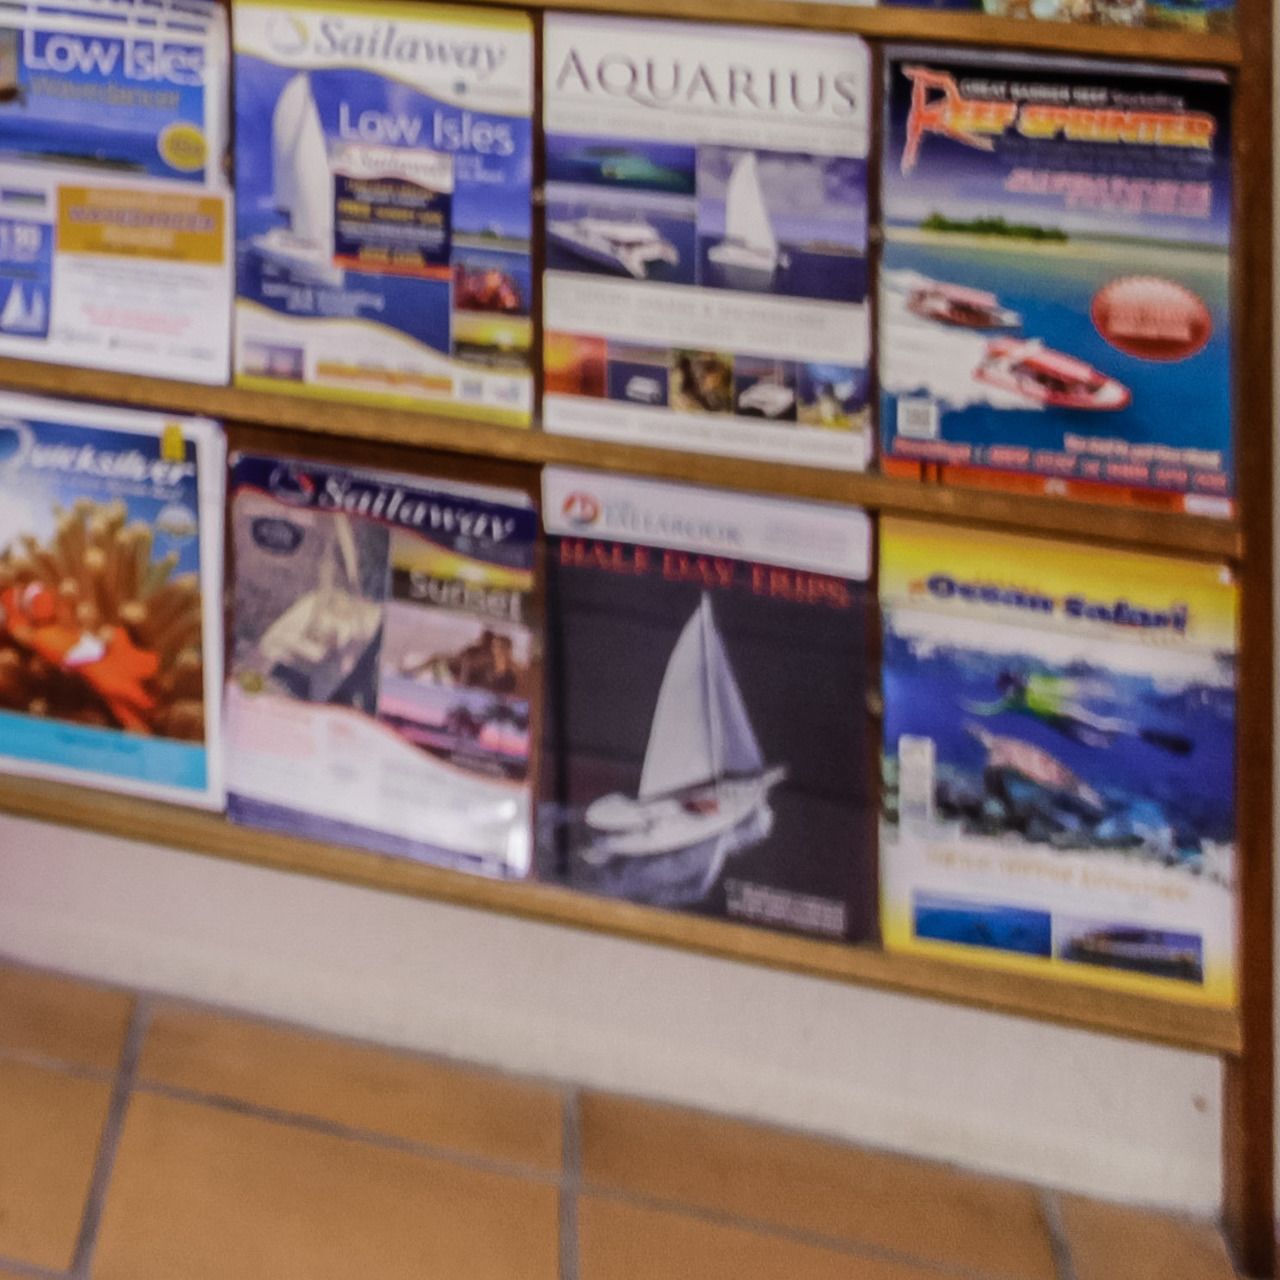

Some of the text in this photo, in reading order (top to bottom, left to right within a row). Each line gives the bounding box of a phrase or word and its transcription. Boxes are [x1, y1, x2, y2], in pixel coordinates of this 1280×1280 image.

[22, 28, 205, 87] Low Isles
[313, 14, 507, 82] Sailaway
[555, 46, 859, 117] AQUARIUS
[339, 101, 517, 158] Low Isles
[900, 65, 1216, 178] REEF SPRINTER
[318, 474, 516, 543] Sailaway
[410, 570, 522, 622] Sunset
[559, 536, 852, 608] HALF DAY TRIPS
[926, 572, 1188, 633] Ocean Safari
